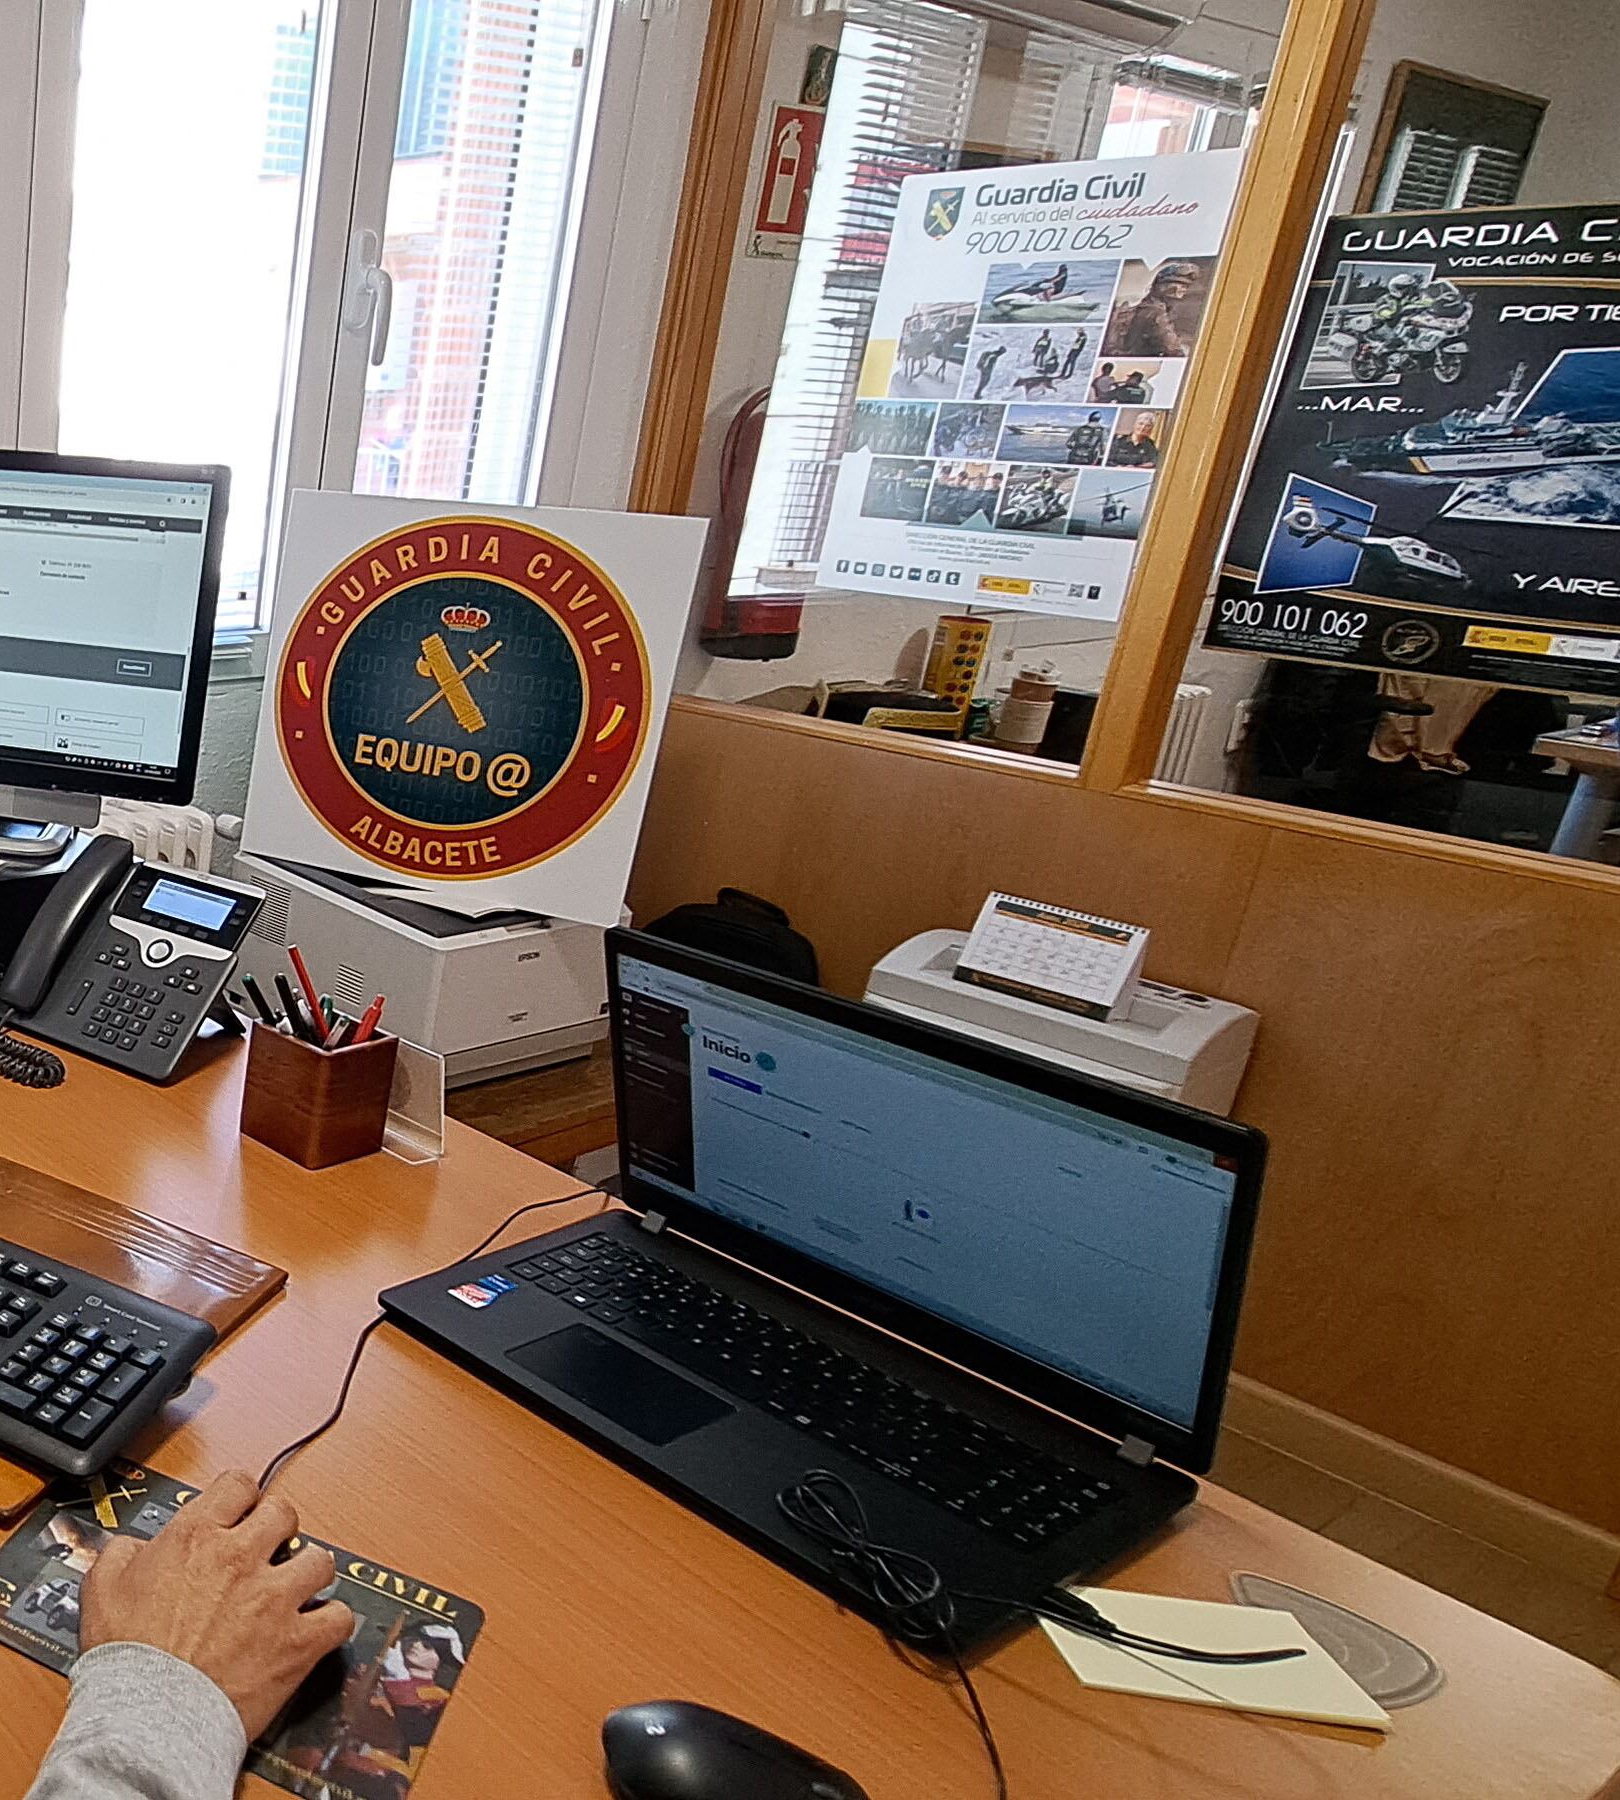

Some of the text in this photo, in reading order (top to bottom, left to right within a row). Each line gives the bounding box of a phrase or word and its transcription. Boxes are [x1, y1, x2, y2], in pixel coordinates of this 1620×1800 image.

[975, 172, 1147, 208] Guardia Civil
[971, 194, 1200, 226] Al servicio del ciudadano
[965, 224, 1134, 256] 900 101 062
[1342, 218, 1620, 252] GUARDIA C
[1448, 250, 1620, 268] VOCACIÓN DE S
[1499, 304, 1580, 323] POR
[322, 534, 621, 657] GUARDIA CIVIL
[1511, 573, 1538, 589] Y
[1221, 599, 1369, 639] 900 101 062
[353, 733, 532, 797] EQUIPO @
[349, 814, 502, 867] ALBACETE
[702, 1034, 751, 1064] Inicio
[347, 1561, 458, 1618] CIVIL
